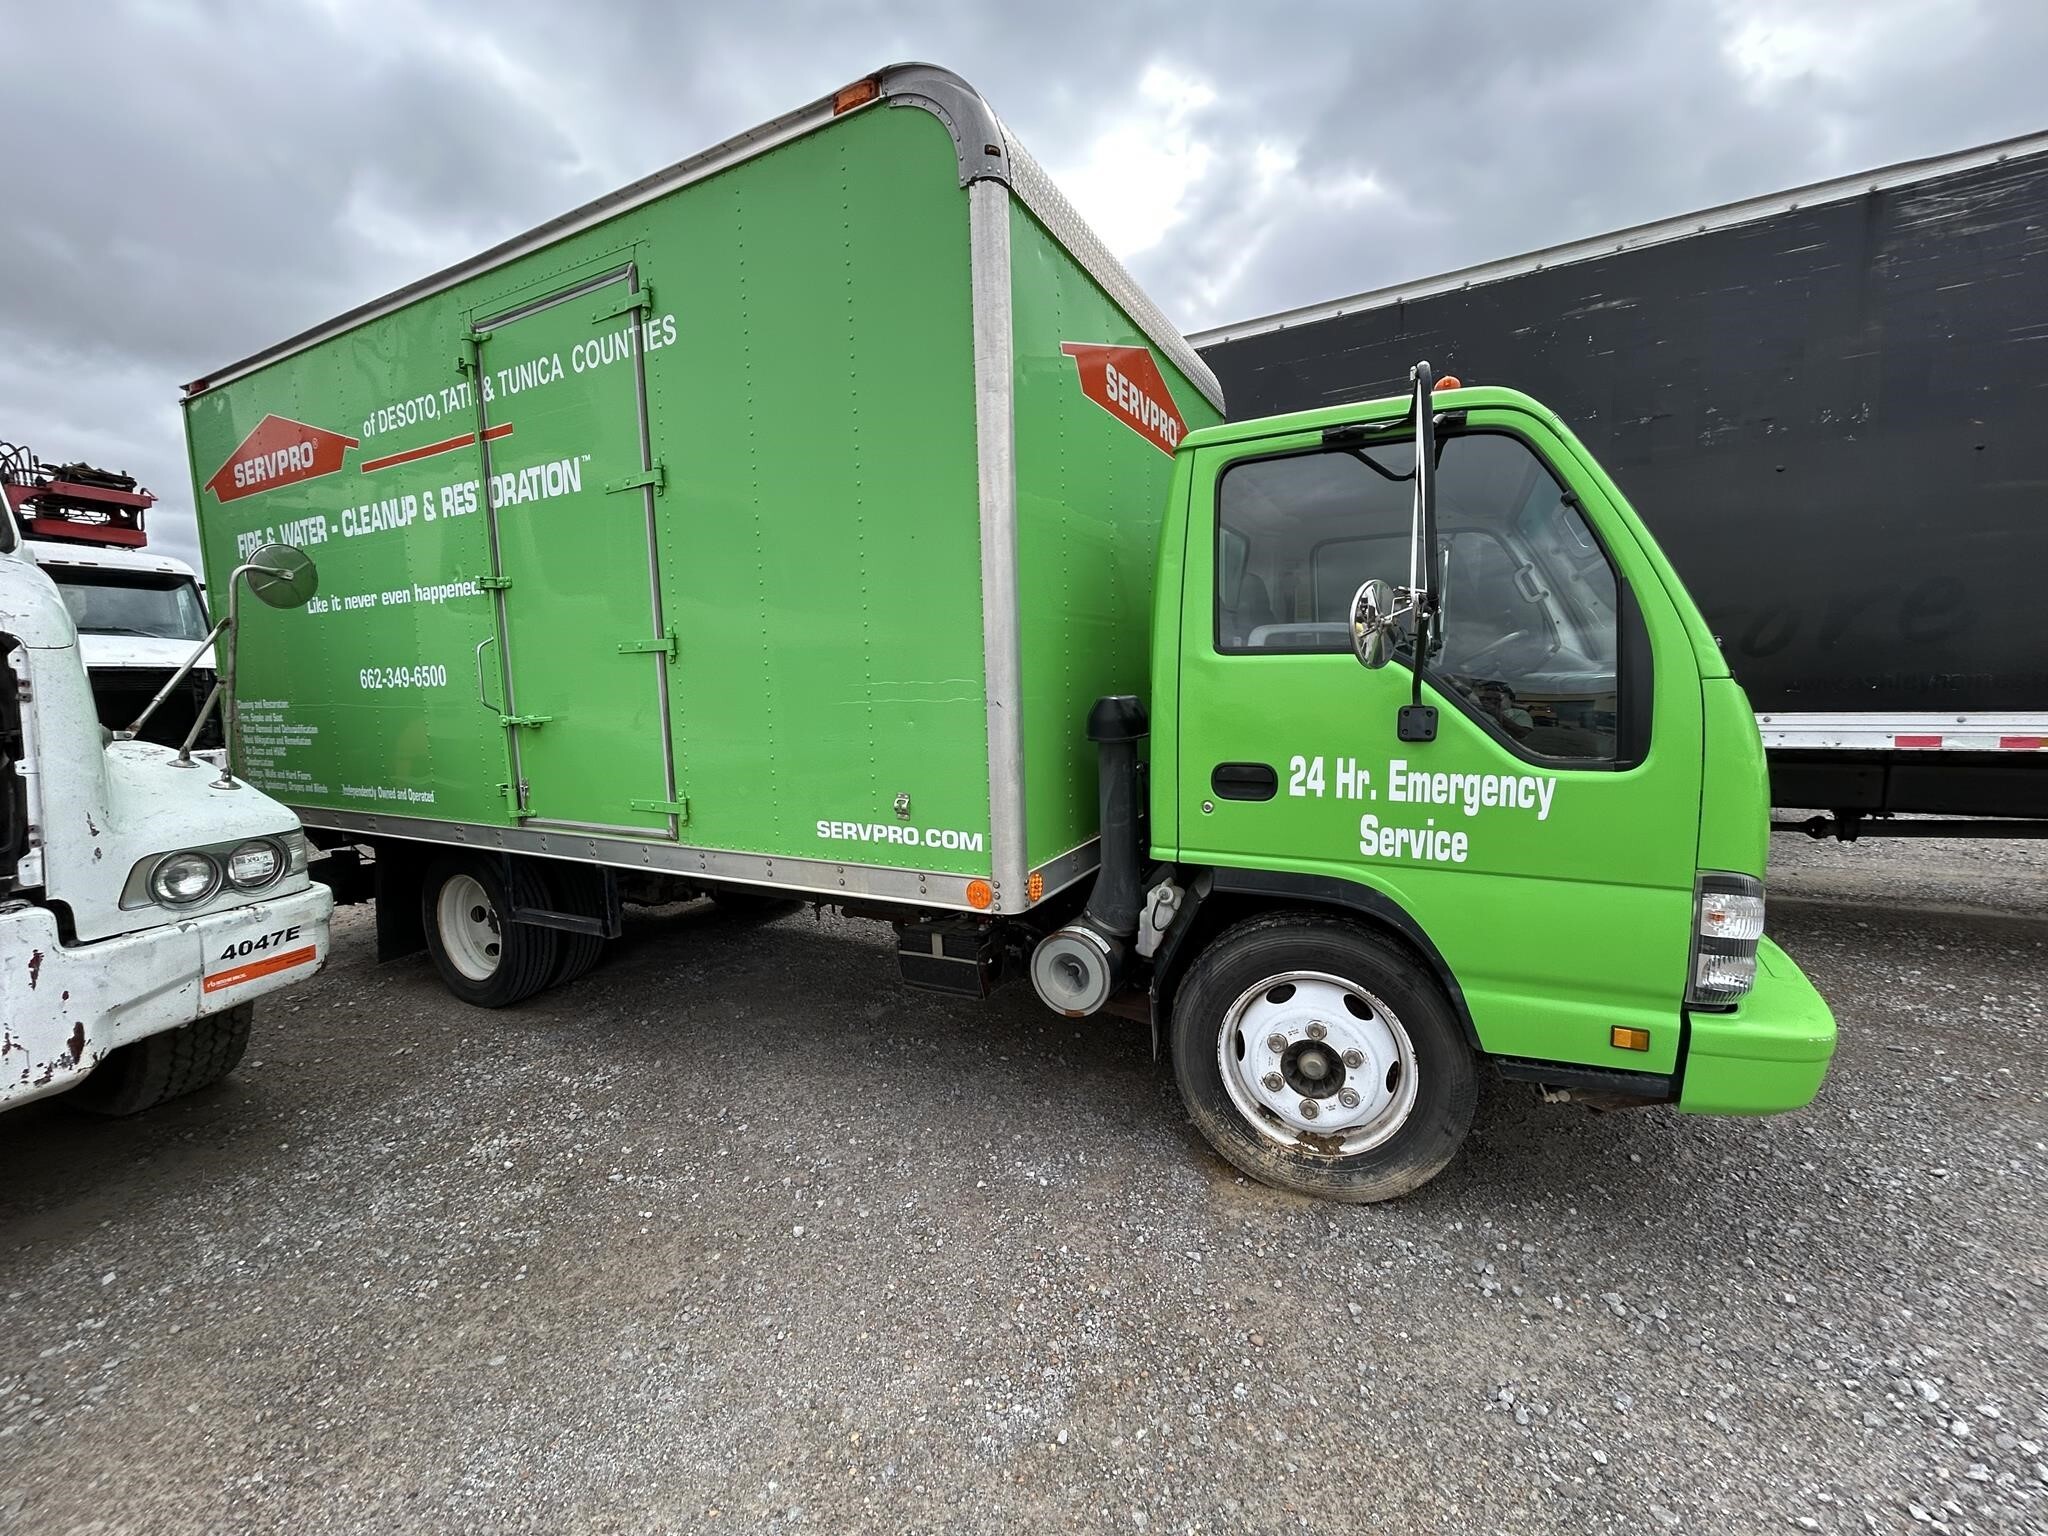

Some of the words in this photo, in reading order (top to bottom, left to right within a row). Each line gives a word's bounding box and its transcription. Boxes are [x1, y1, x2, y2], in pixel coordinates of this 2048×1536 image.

[363, 412, 377, 438] of
[378, 394, 441, 433] DESOTO,
[483, 376, 495, 402] &
[497, 353, 565, 397] TUNICA
[572, 314, 677, 373] COUNTIES
[237, 530, 262, 559] FIRE
[266, 527, 276, 545] &
[279, 515, 328, 548] WATER
[341, 495, 417, 538] CLEANUP
[423, 491, 437, 522] &
[307, 597, 329, 614] Like
[331, 594, 342, 612] it
[345, 594, 378, 610] never
[381, 589, 411, 606] even
[360, 664, 447, 689] 662-349-6500
[341, 784, 377, 801] Independently
[377, 786, 396, 799] Owned
[396, 787, 408, 801] and
[407, 788, 436, 804] Operated
[1288, 755, 1326, 798] 24
[1335, 757, 1377, 801] Hr.
[1388, 759, 1557, 821] Emergency
[816, 820, 983, 852] SERVPRO.COM
[1359, 813, 1469, 863] Service
[220, 925, 301, 960] 4047E
